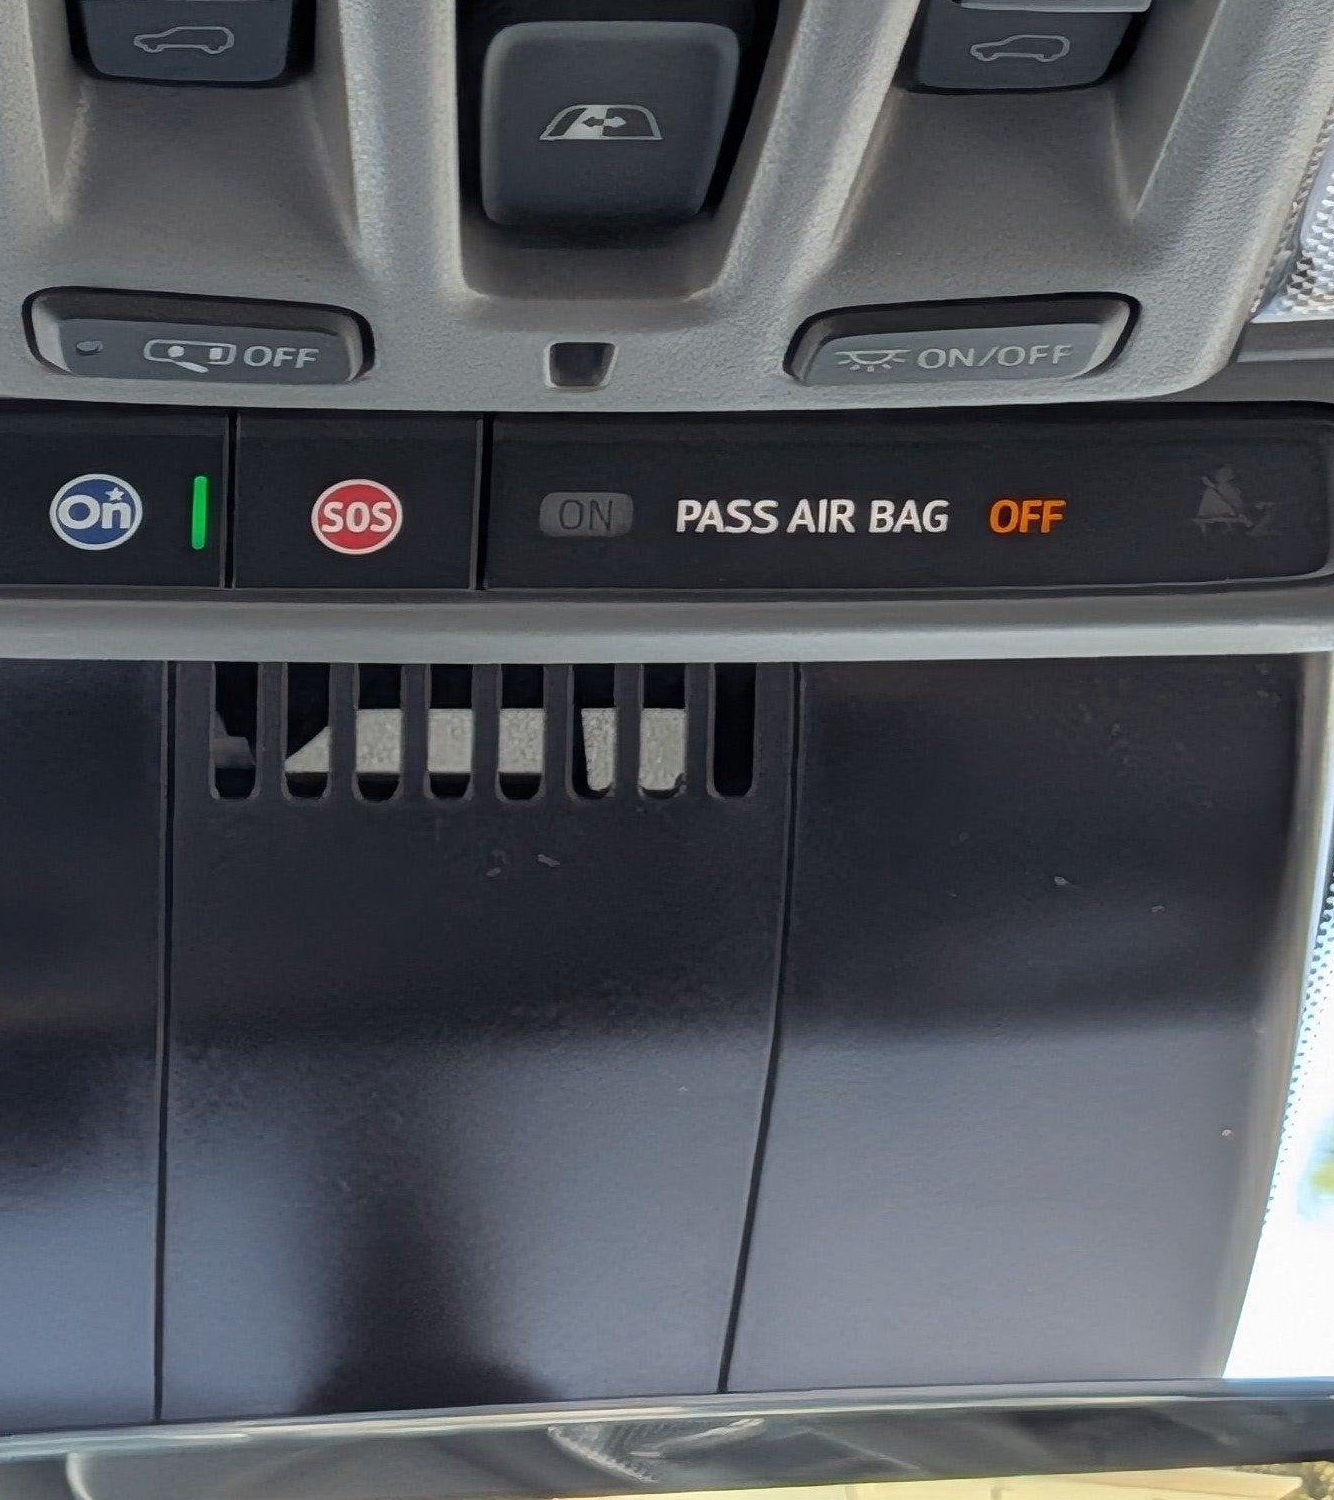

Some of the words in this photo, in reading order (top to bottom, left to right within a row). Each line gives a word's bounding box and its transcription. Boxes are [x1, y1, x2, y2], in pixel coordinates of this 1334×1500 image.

[243, 344, 319, 371] OFF
[916, 343, 1074, 371] ON/OFF
[58, 492, 132, 530] On
[319, 500, 394, 534] SOS
[558, 499, 613, 532] ON
[675, 499, 779, 534] PASS
[786, 499, 856, 534] AIR
[868, 499, 950, 534] BAG
[989, 499, 1067, 534] OFF
